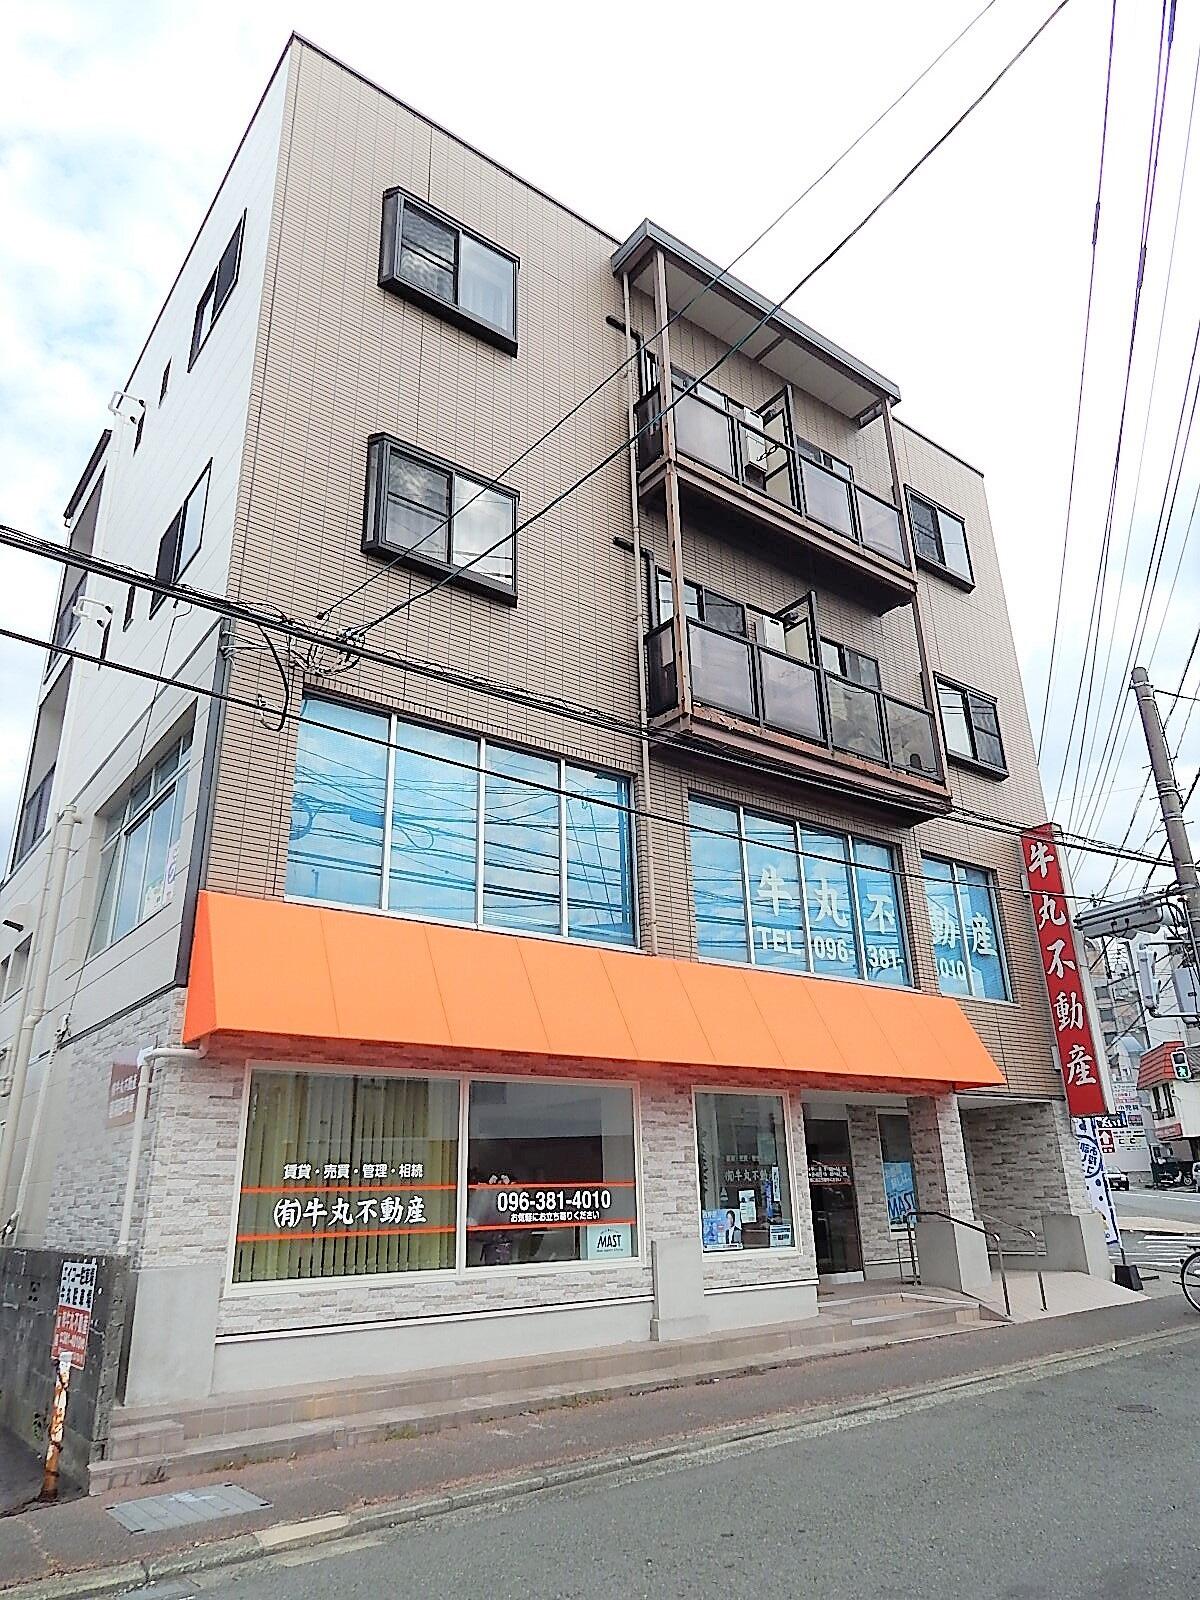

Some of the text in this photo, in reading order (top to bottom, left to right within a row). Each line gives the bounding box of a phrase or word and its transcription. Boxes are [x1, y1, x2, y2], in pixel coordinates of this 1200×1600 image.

[756, 926, 802, 955] TEL
[1029, 841, 1096, 1086] 牛丸不動産
[497, 1190, 611, 1212] 096-381-4010
[510, 1211, 600, 1223] お気軽にお立ち寄りください
[596, 1234, 622, 1249] MAST
